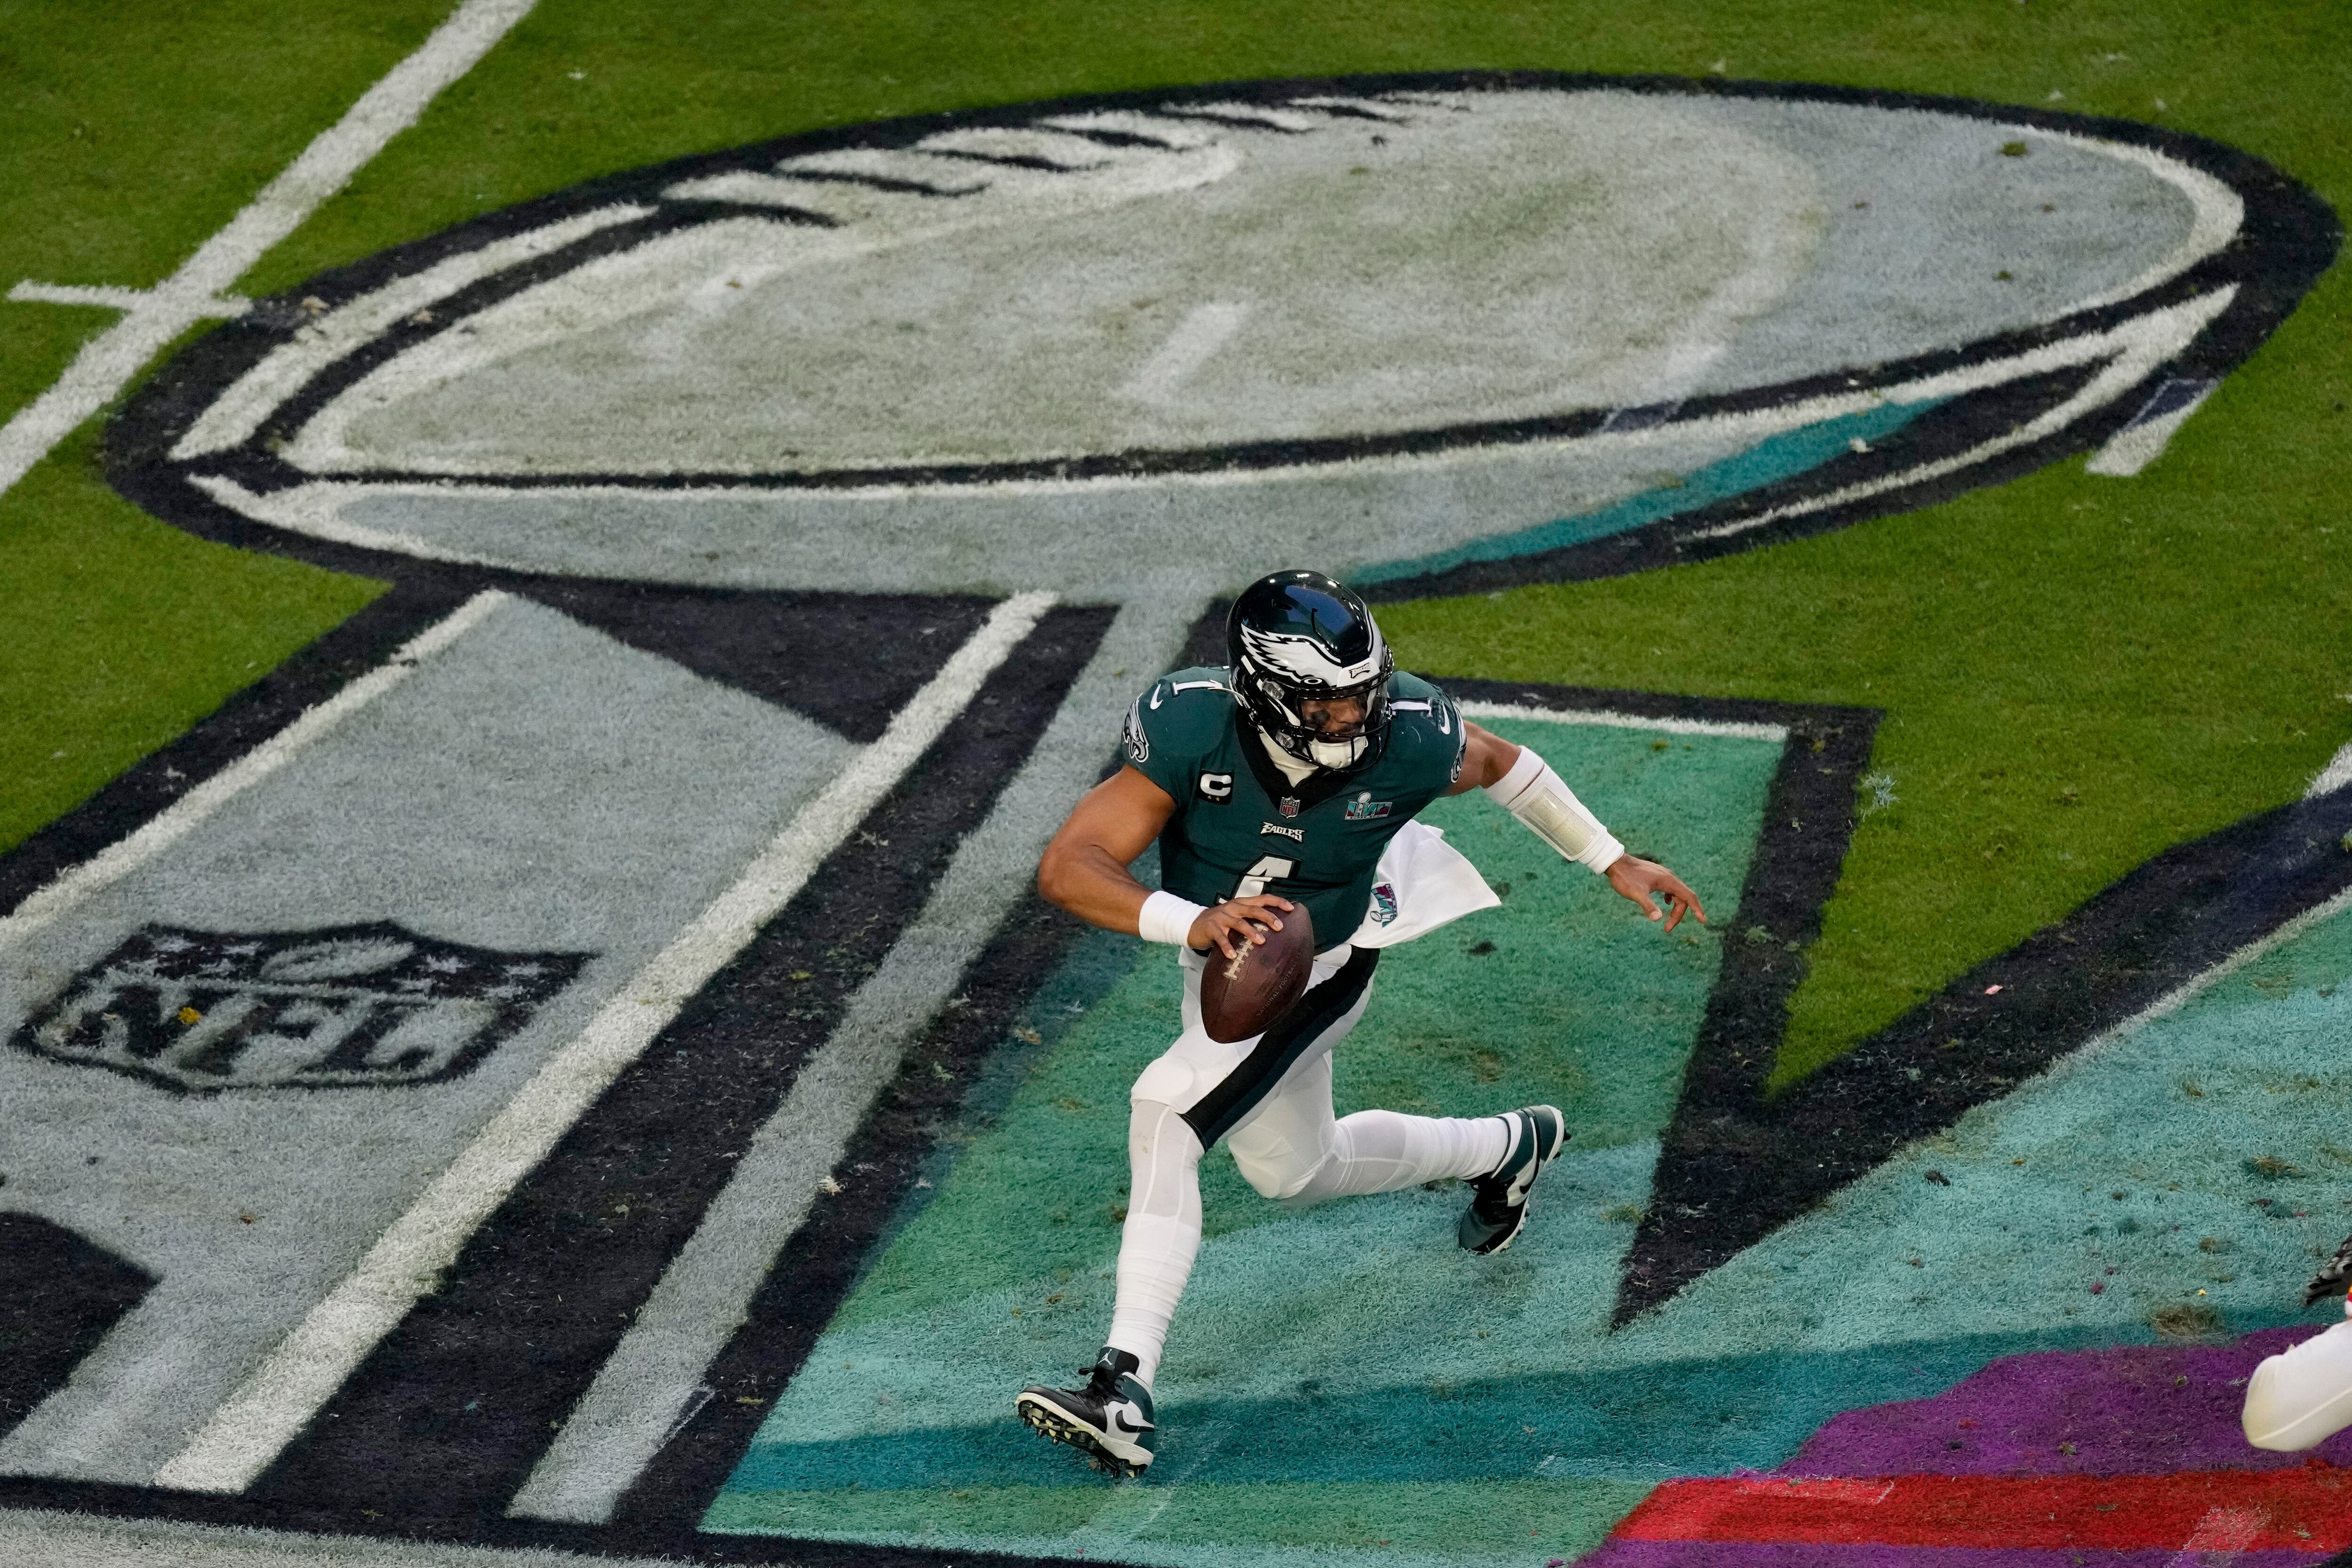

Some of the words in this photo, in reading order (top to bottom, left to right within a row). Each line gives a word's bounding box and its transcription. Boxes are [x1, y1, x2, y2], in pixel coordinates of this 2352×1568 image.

[1200, 774, 1232, 797] C
[1282, 805, 1296, 815] NFL
[1256, 991, 1279, 1016] NATIONAL
